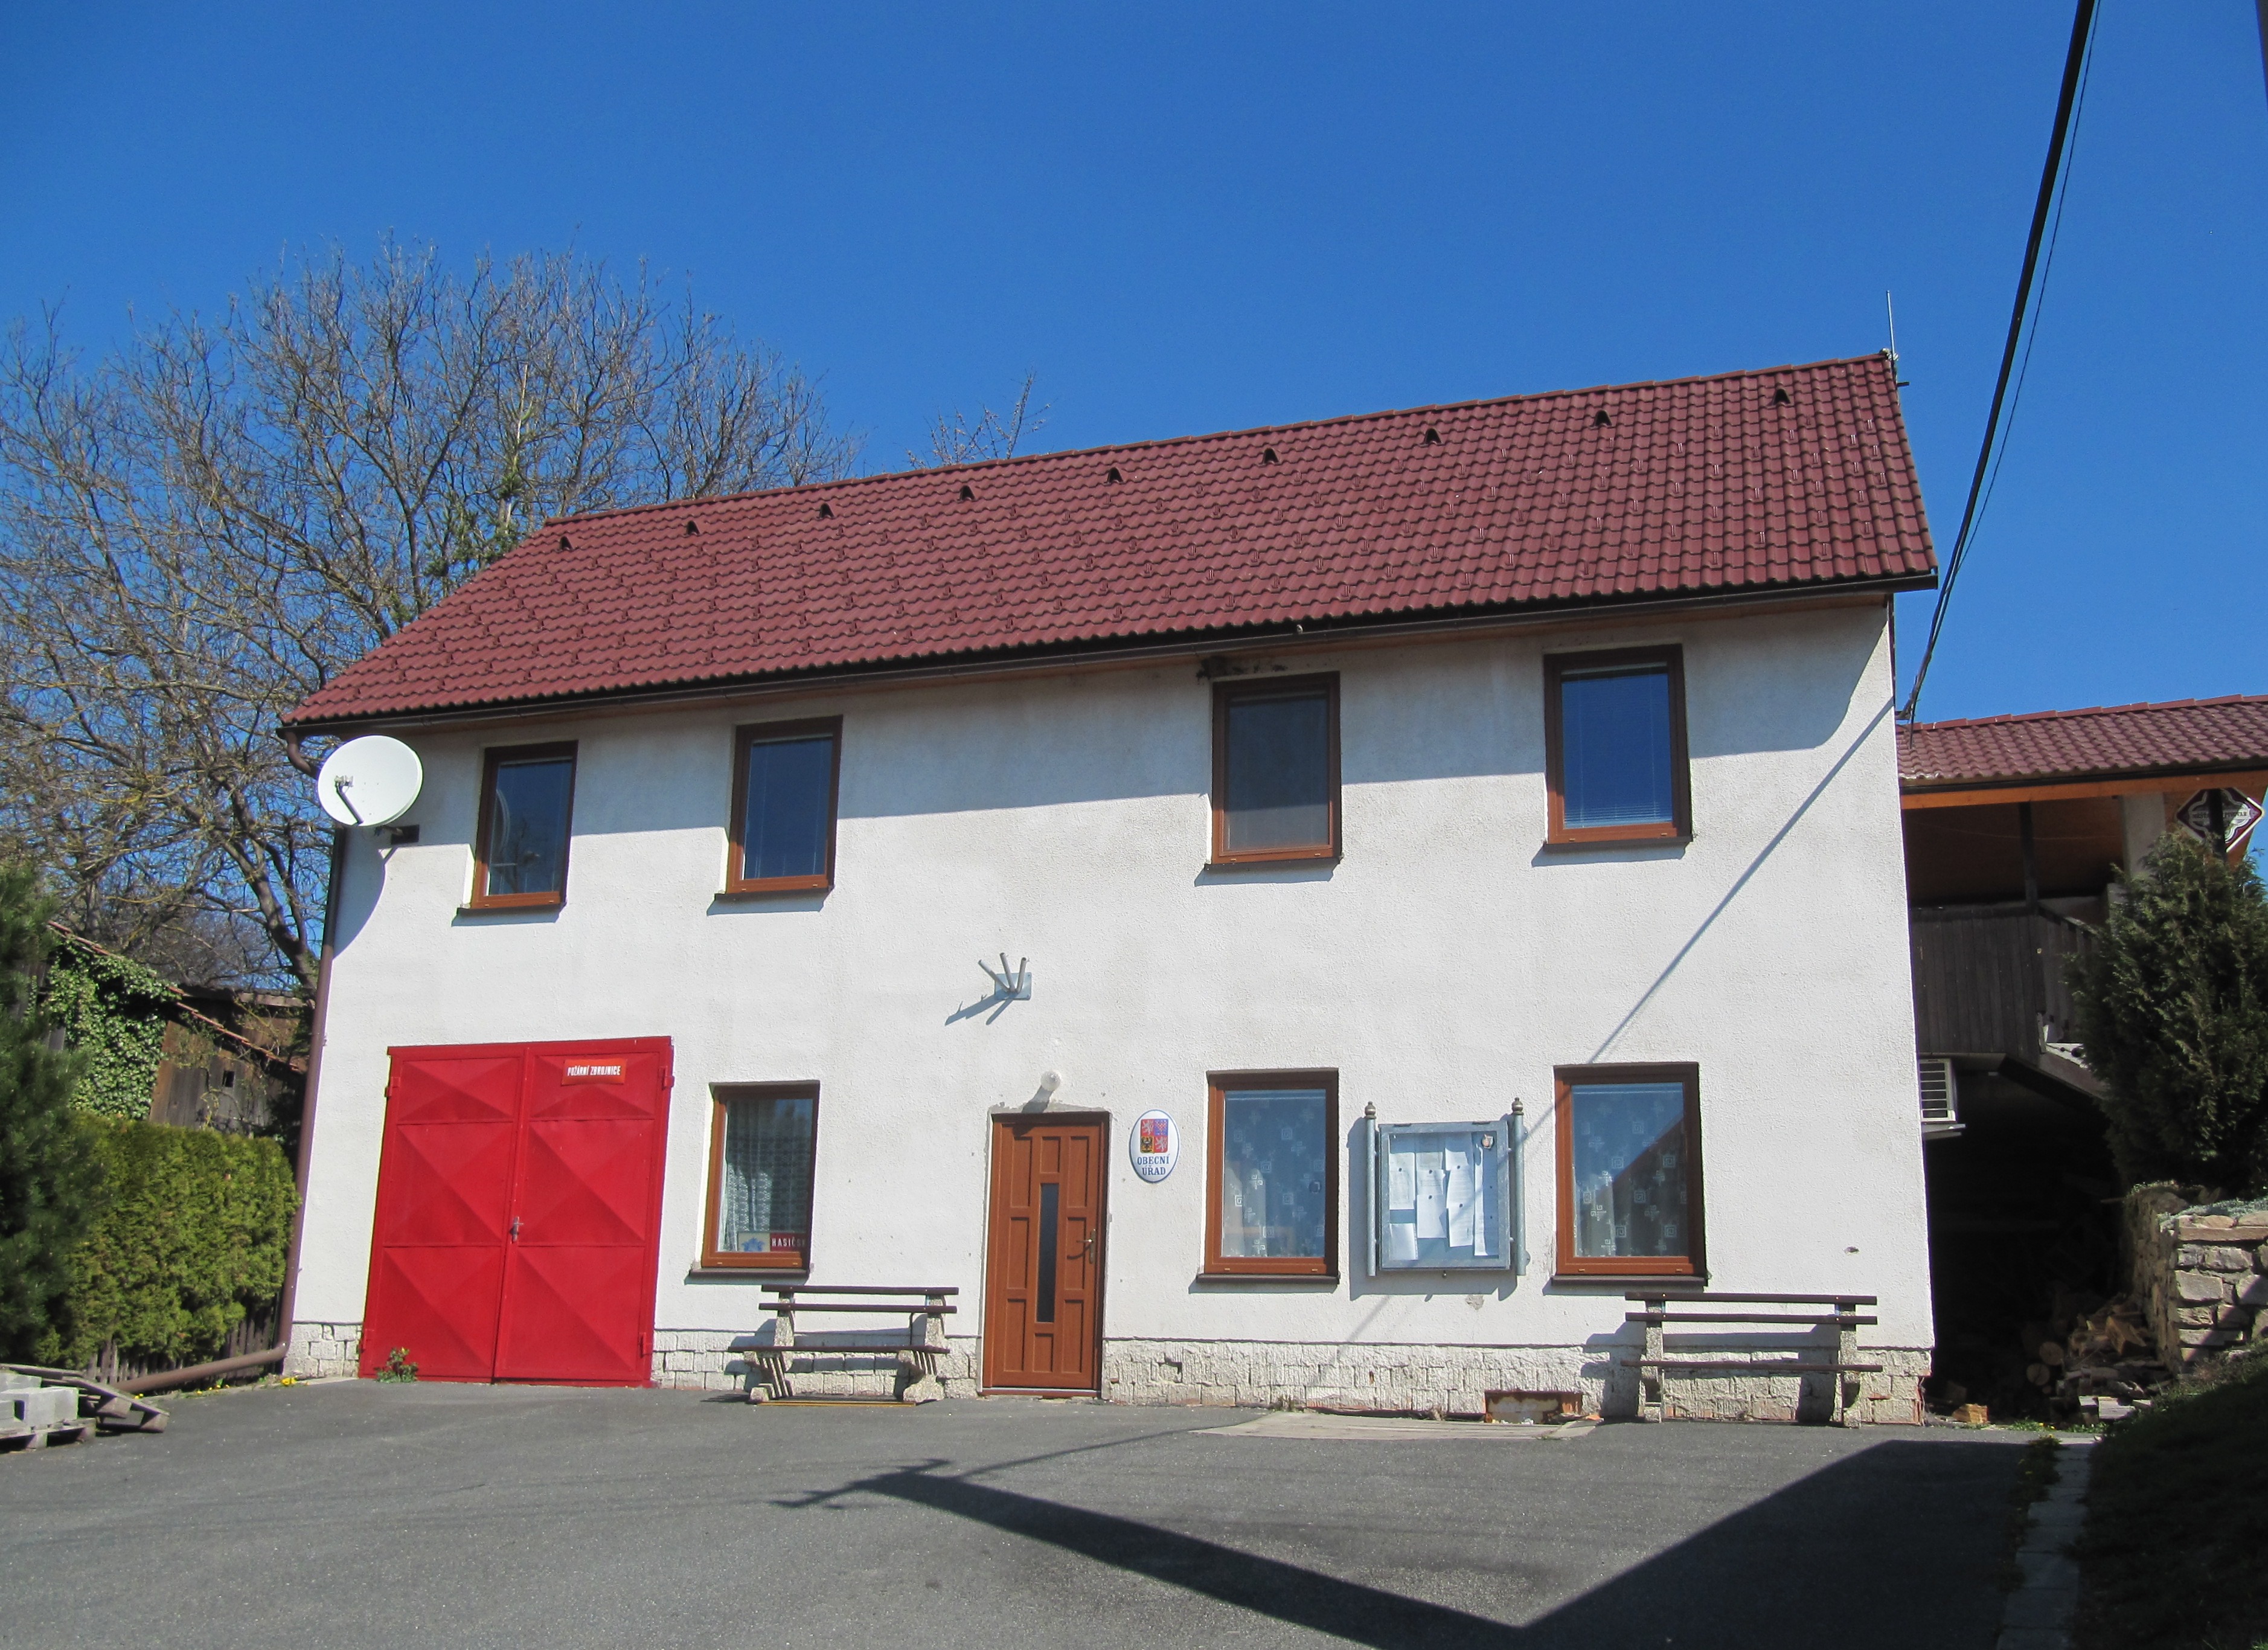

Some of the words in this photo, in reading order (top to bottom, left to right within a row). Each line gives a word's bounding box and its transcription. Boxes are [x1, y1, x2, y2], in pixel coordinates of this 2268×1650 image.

[567, 1065, 589, 1076] POŽÁRNÍ
[590, 1065, 621, 1076] ZBROJNICE
[1137, 1154, 1170, 1165] OBECNÍ
[1142, 1165, 1166, 1176] ÚŘAD
